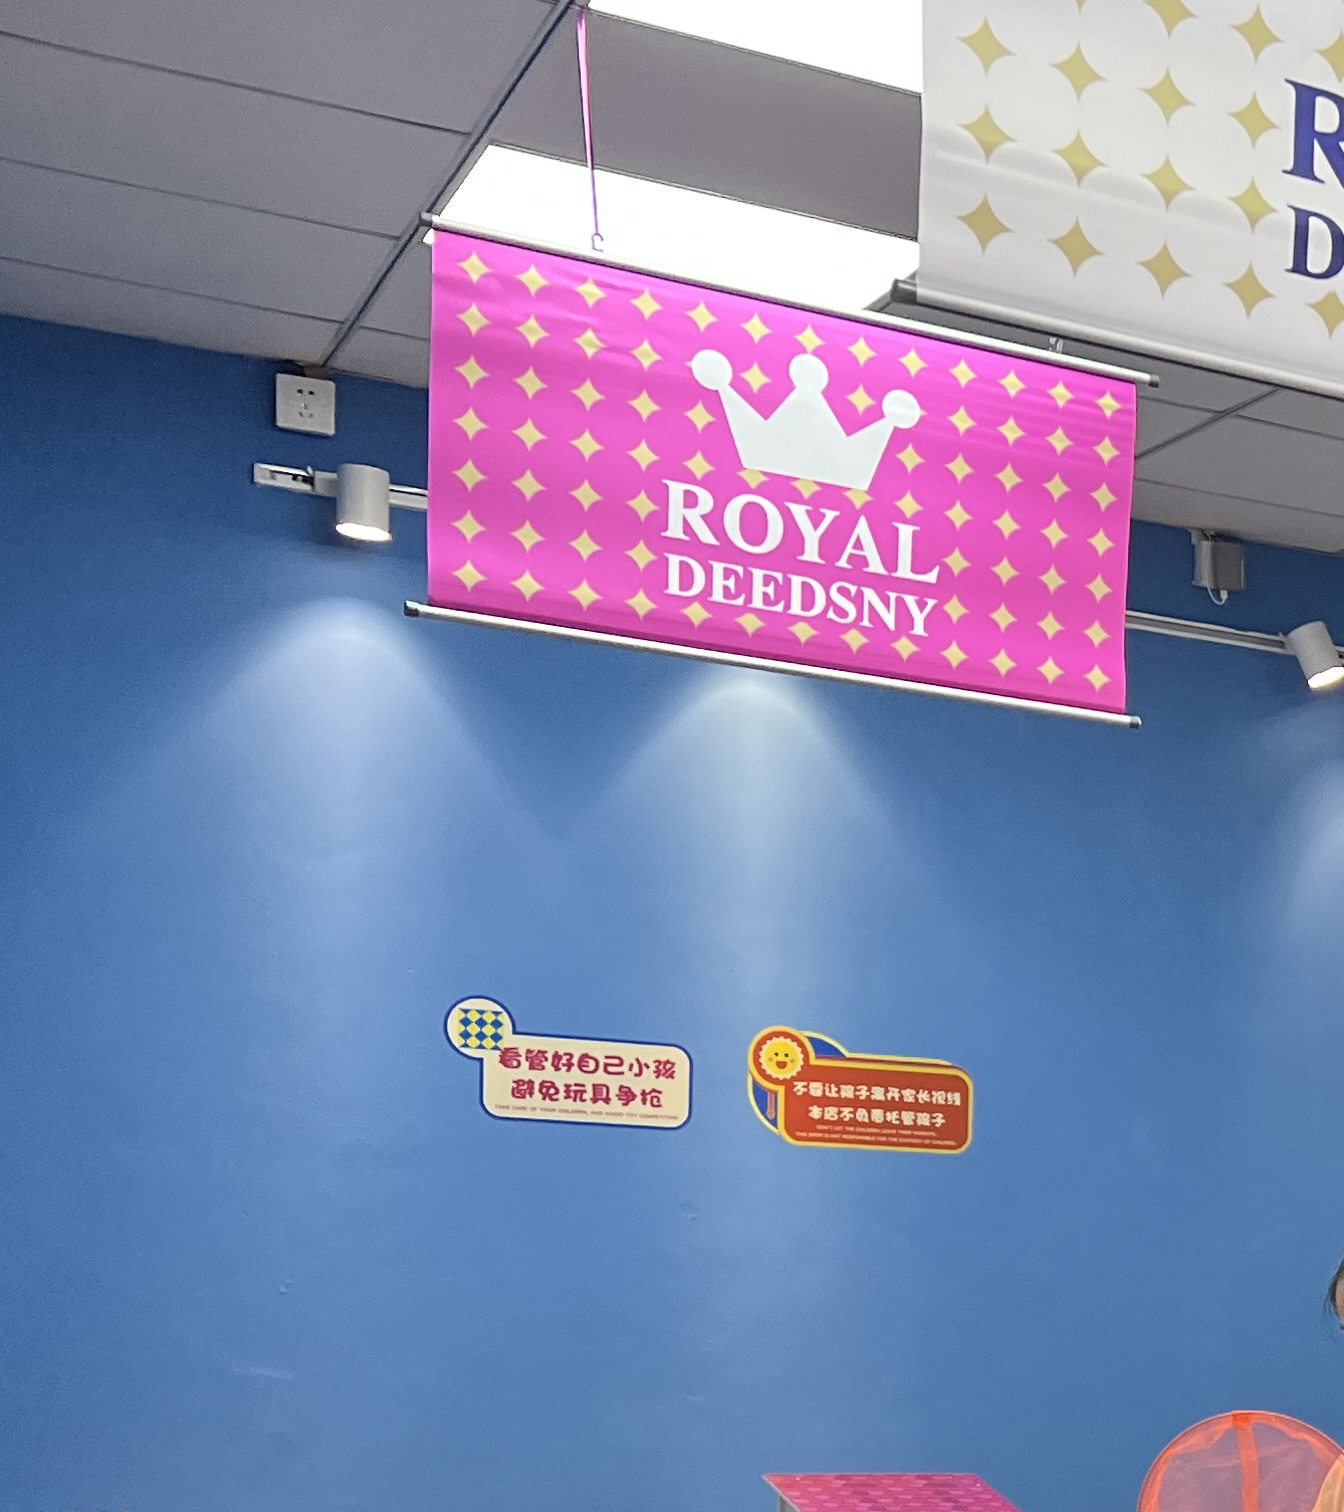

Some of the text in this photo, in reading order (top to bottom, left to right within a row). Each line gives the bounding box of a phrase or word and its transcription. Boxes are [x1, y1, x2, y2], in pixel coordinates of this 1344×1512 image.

[661, 479, 940, 585] ROYAL
[663, 552, 938, 637] DEEDSNY
[498, 1047, 676, 1080] 看管好自己小孩
[511, 1078, 663, 1108] 避免玩具争抢
